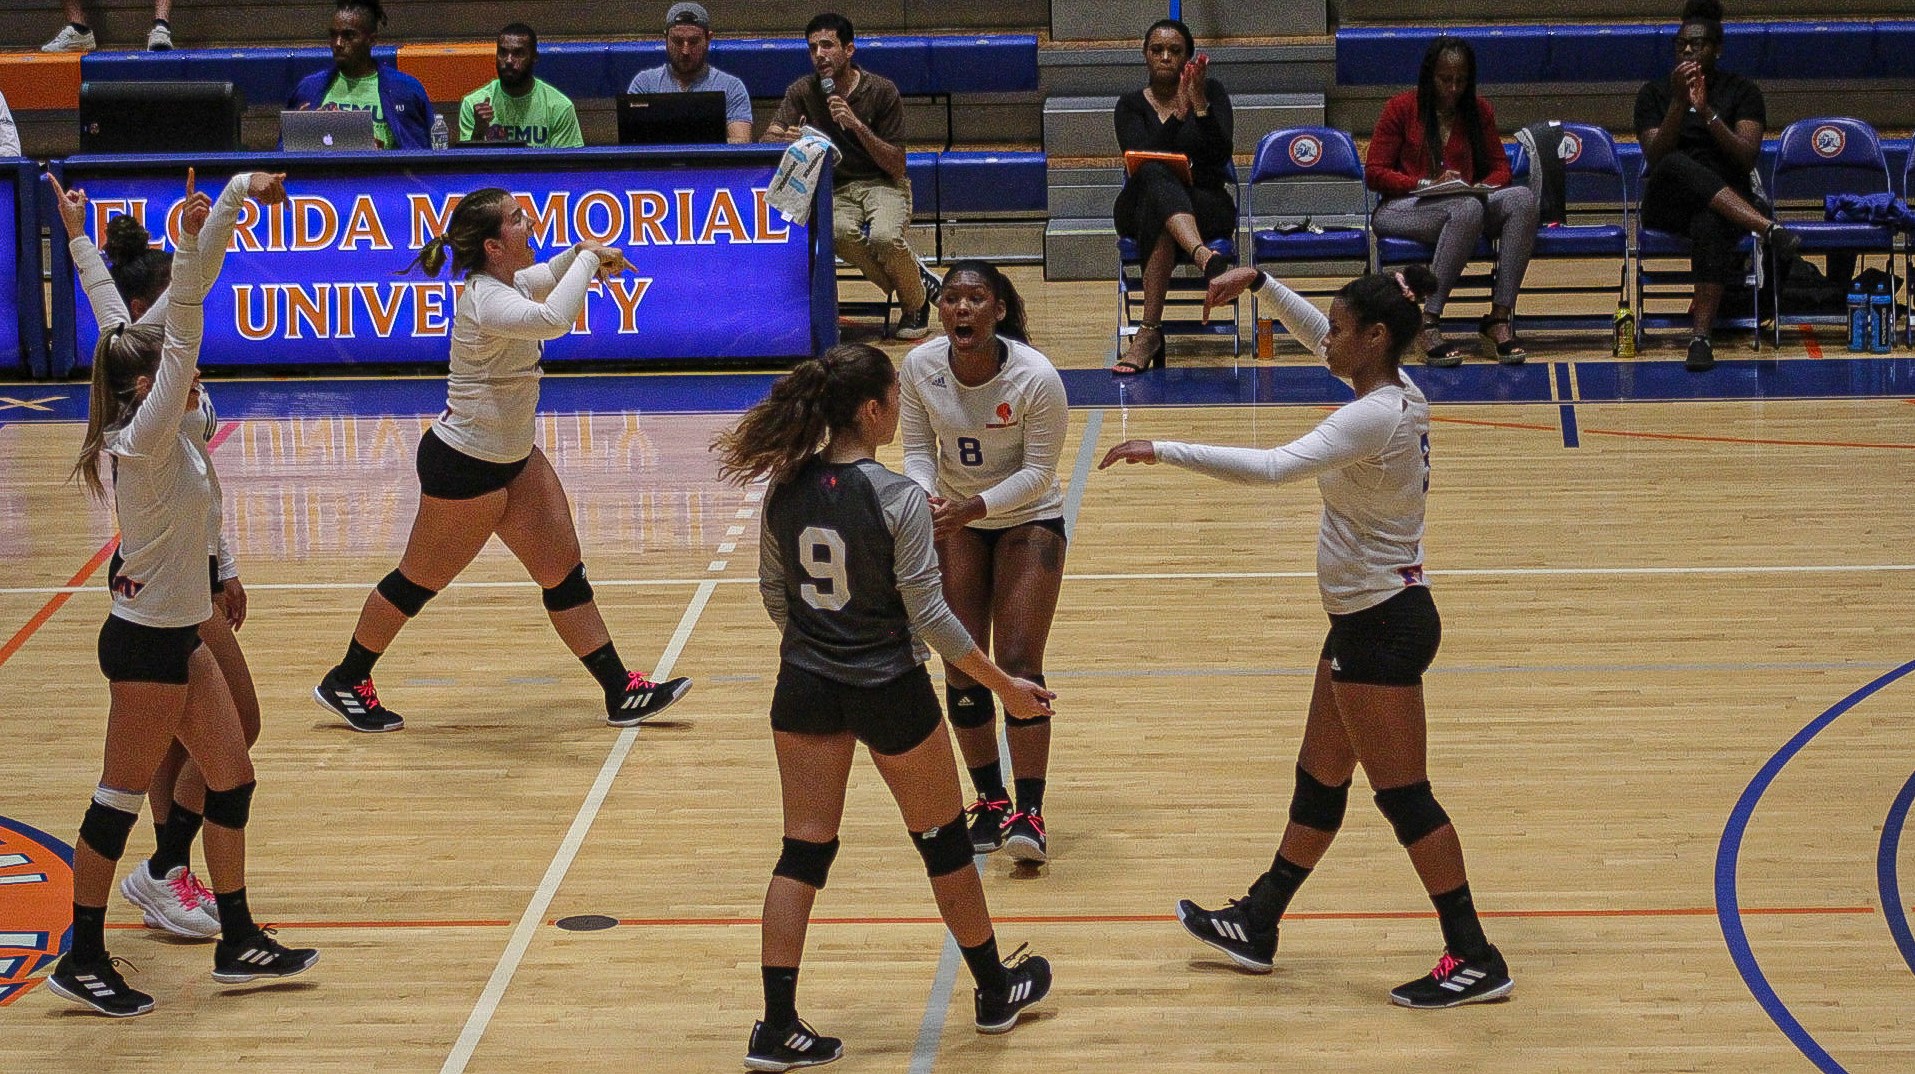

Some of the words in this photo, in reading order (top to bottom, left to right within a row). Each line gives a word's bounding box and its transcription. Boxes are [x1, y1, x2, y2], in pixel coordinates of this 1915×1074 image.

[407, 188, 791, 250] MMORIAL
[232, 276, 654, 340] UNIVETY
[957, 436, 984, 467] 8
[798, 526, 852, 611] 9
